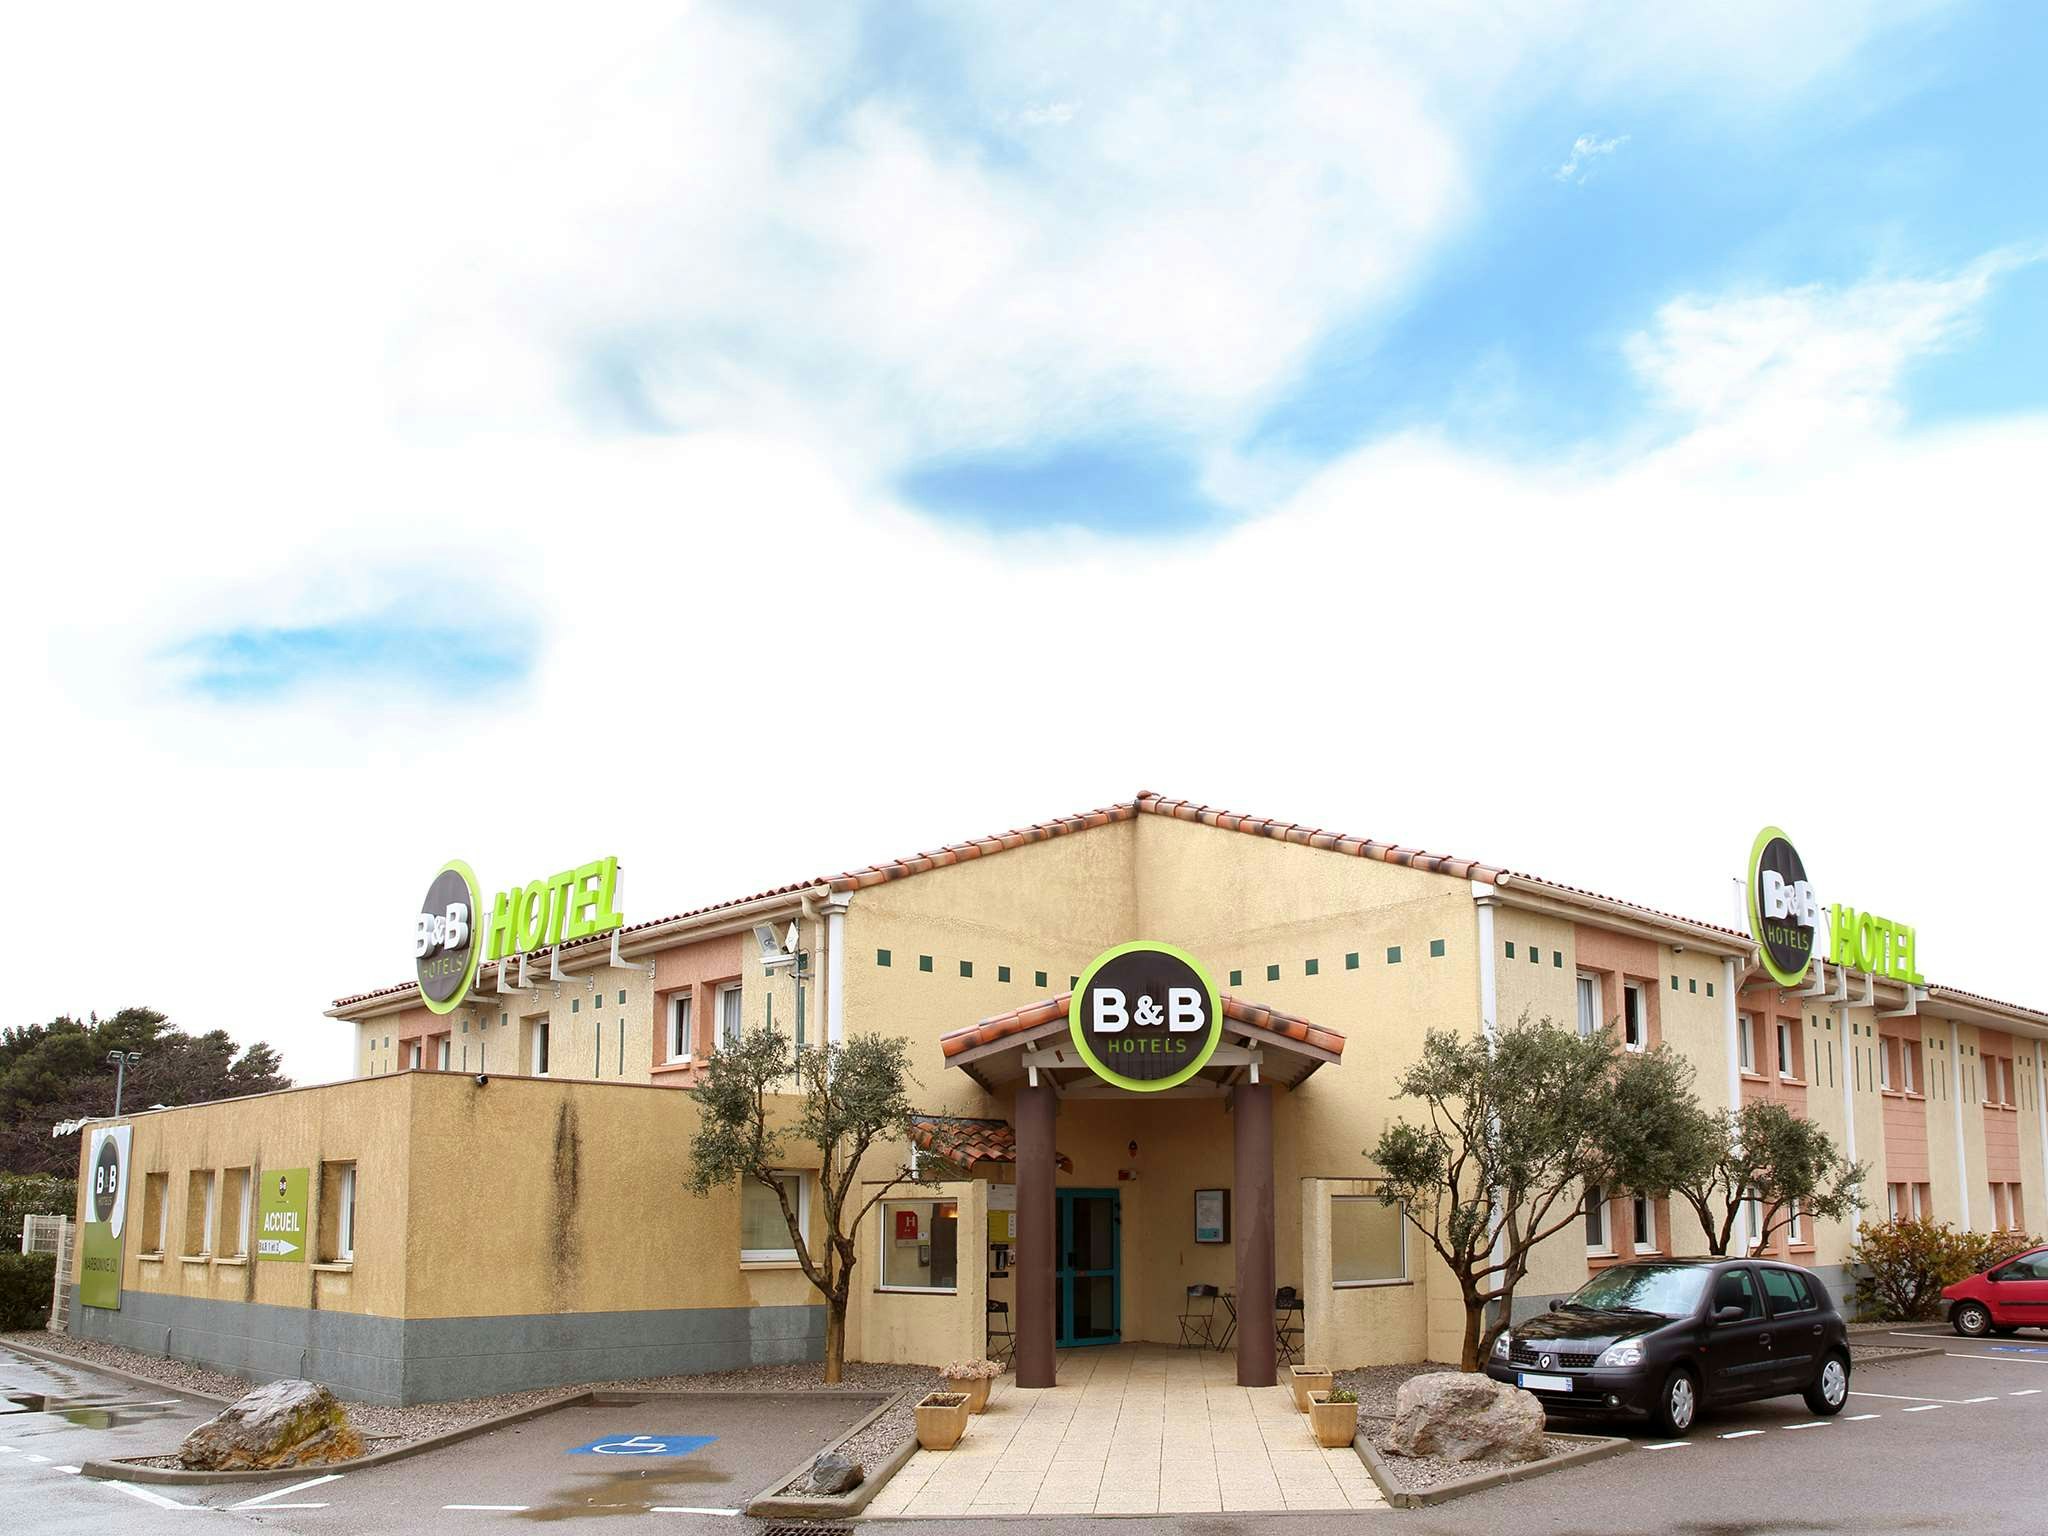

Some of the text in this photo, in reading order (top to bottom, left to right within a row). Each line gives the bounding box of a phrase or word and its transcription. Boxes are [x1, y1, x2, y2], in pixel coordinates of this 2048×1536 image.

[487, 856, 623, 960] HOTEL
[414, 902, 468, 959] B&B
[1768, 924, 1809, 951] HOTELS
[1829, 903, 1924, 985] HOTEL
[422, 954, 463, 978] HOTELS
[1093, 987, 1205, 1033] B&B
[1108, 1039, 1187, 1053] HOTELS
[96, 1165, 116, 1194] BB
[263, 1211, 300, 1232] ACCUEIL
[906, 1216, 916, 1227] H
